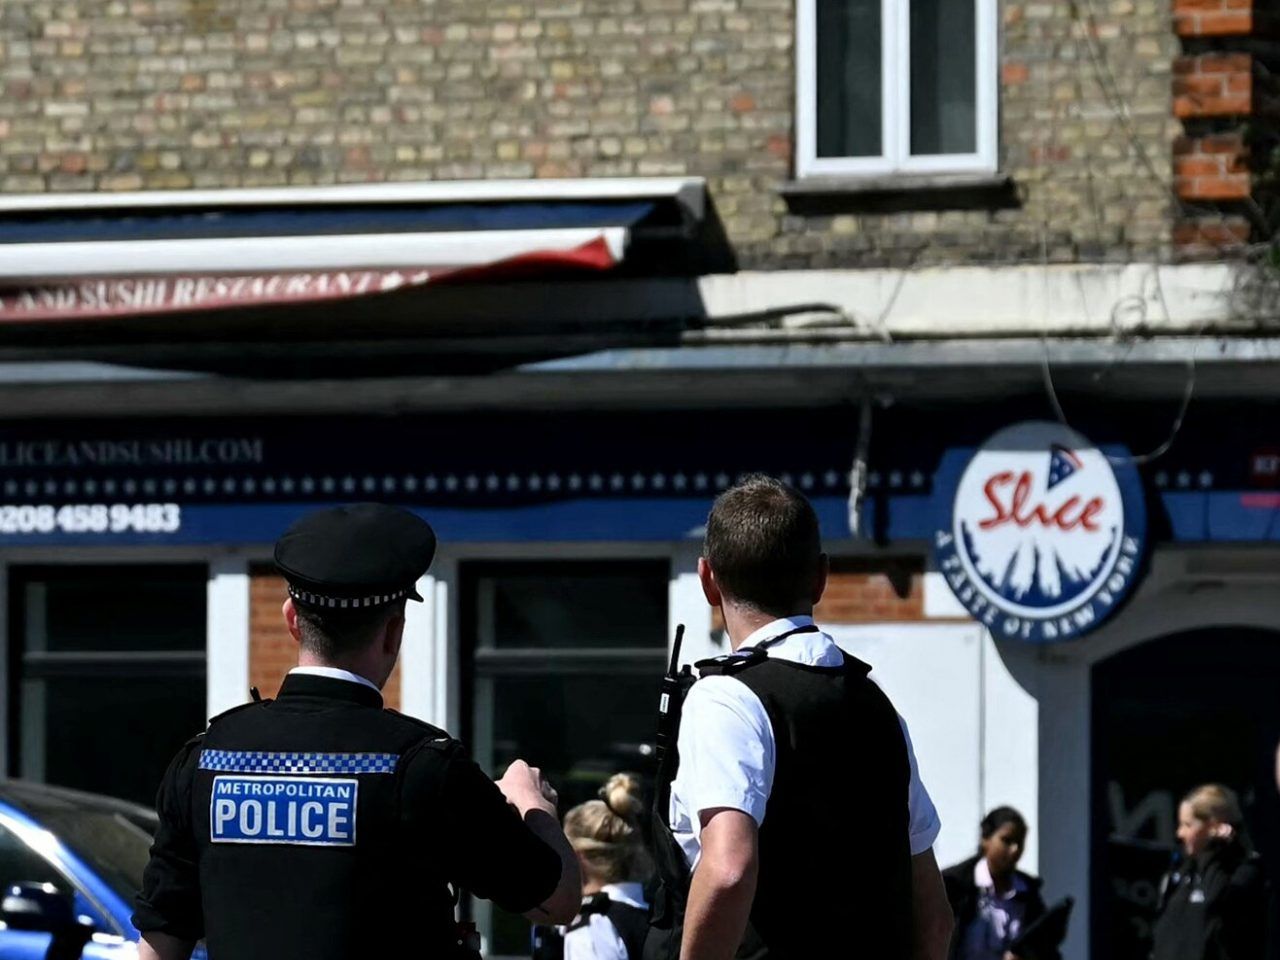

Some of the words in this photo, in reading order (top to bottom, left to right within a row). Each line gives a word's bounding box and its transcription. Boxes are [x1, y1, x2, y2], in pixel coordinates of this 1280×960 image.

[82, 280, 167, 310] SUSHI
[173, 271, 379, 307] RESTAURANT
[978, 470, 1104, 532] Slice
[941, 553, 999, 625] TASTE
[1042, 604, 1096, 639] NEW
[1097, 536, 1139, 606] YORK
[217, 782, 350, 798] METROPOLITAN
[215, 799, 349, 839] POLICE
